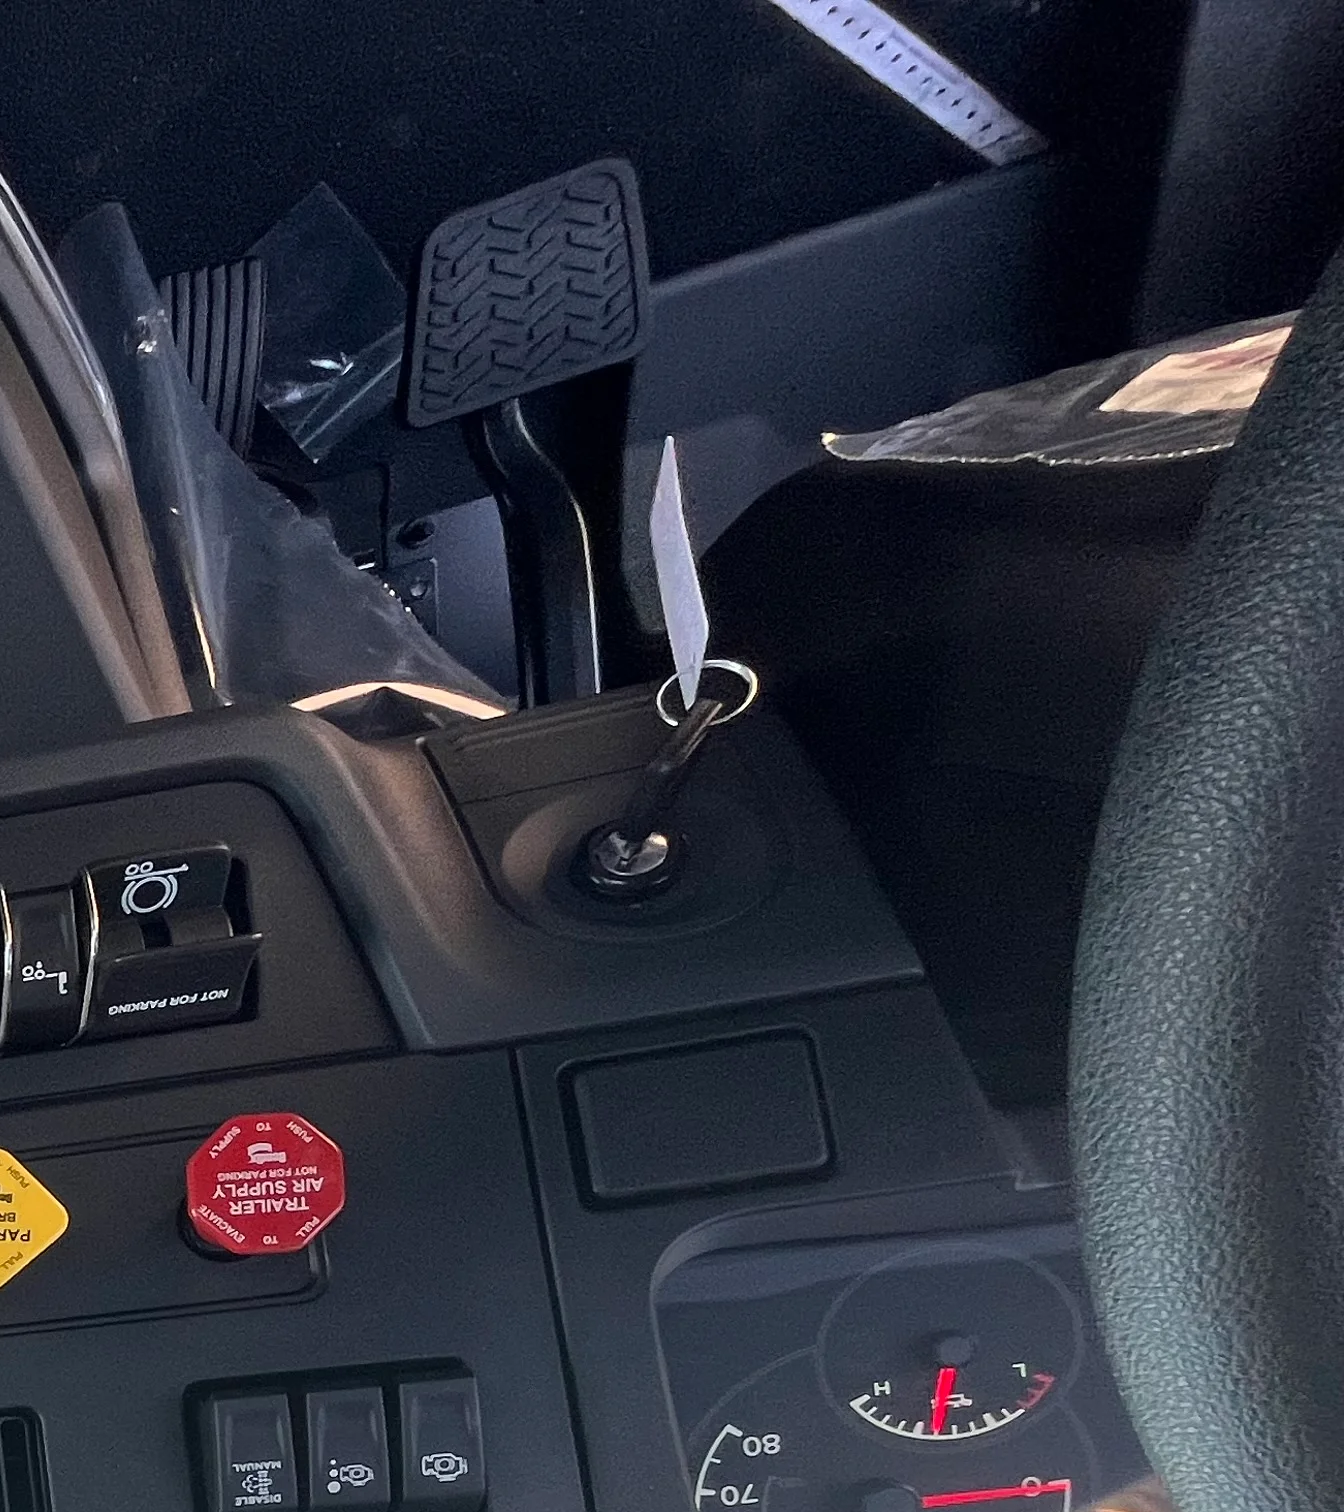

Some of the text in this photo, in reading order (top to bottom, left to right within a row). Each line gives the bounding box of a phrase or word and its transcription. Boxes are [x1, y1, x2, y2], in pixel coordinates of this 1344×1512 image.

[108, 988, 229, 1016] NOT FOR PARKING
[208, 1121, 314, 1159] PUSH TO SUPPLY
[6, 1166, 30, 1189] PUSH
[217, 1166, 317, 1182] NOT FOR PARKING
[212, 1177, 324, 1200] AIR SUPPLY
[229, 1196, 309, 1215] TRAILER
[197, 1204, 320, 1245] PULL TO EVACUATE
[0, 1251, 23, 1270] PULL
[1012, 1363, 1027, 1378] L
[874, 1380, 891, 1396] H
[743, 1434, 781, 1457] 80
[232, 1460, 282, 1473] MANUAL
[235, 1493, 282, 1506] DISABLE
[721, 1483, 759, 1505] 70
